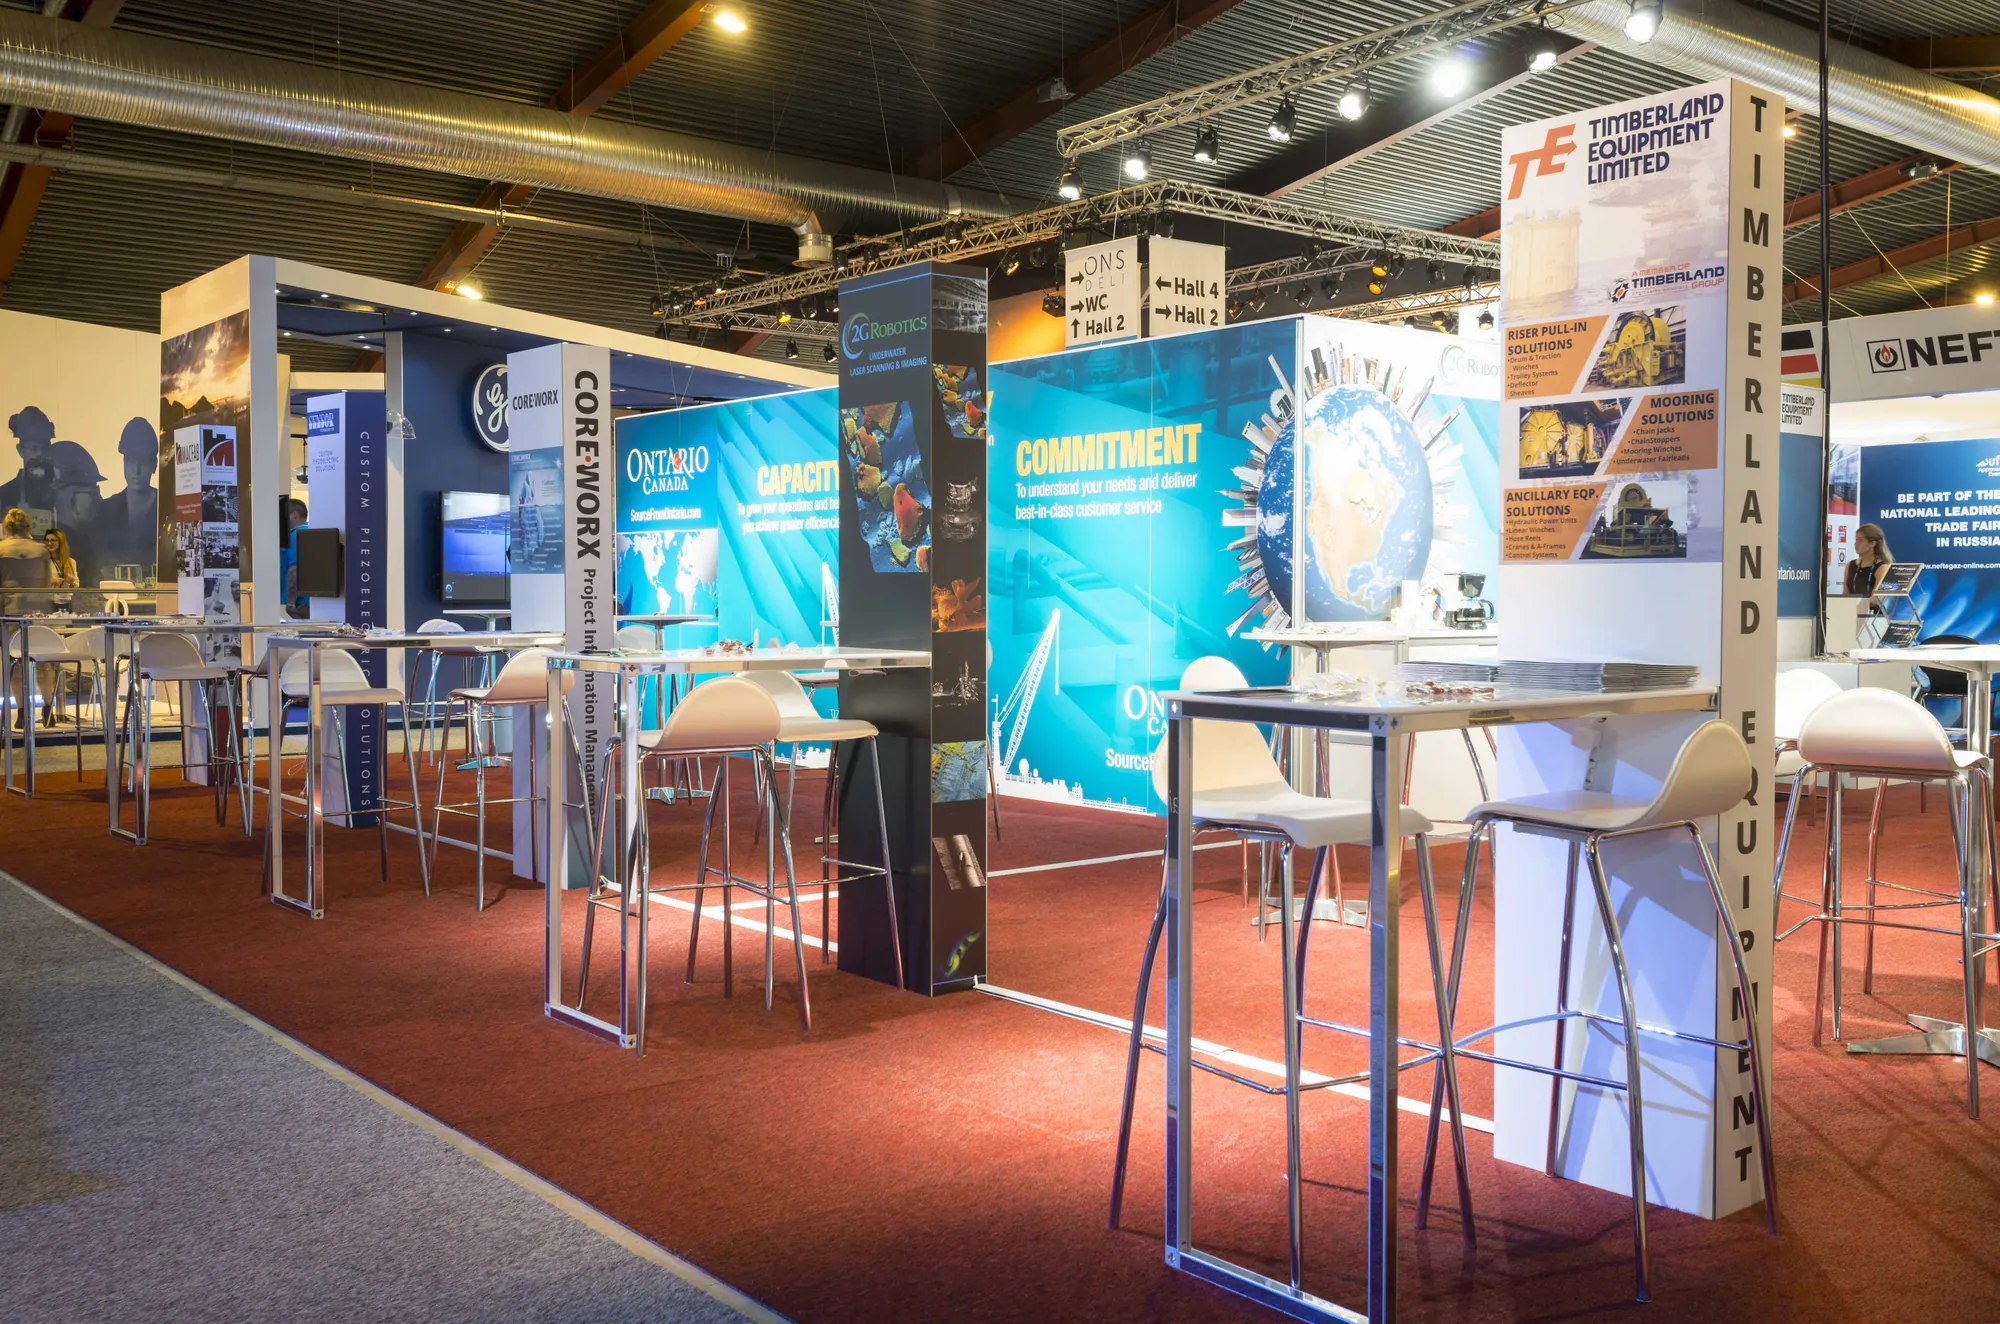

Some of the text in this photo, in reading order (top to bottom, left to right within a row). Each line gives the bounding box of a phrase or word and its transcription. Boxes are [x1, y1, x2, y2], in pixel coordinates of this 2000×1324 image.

[1588, 93, 1724, 139] TIMBERLAND
[1588, 118, 1714, 162] EQUIPMENT
[1588, 151, 1670, 185] LIMITED
[1639, 265, 1676, 276] MEMBER
[1677, 263, 1691, 271] OF
[1085, 273, 1125, 292] DELI
[1631, 266, 1725, 289] TIMBERLAND
[1691, 278, 1724, 289] GROUP
[1174, 277, 1219, 299] Hall 4
[1175, 305, 1219, 326] Hall 2
[1086, 314, 1125, 336] Hall 2
[1508, 321, 1587, 341] RISER PULL-IN
[869, 347, 907, 361] UNDERWATER
[1507, 338, 1573, 356] SOLUTIONS
[1510, 355, 1528, 364] Drum
[1535, 352, 1562, 361] Traction
[1740, 95, 1769, 635] TIMBERLAND
[849, 367, 866, 377] LASER
[866, 362, 895, 374] SCANNING
[901, 356, 927, 368] IMAGING
[1512, 363, 1539, 371] Winches
[1510, 369, 1558, 382] Trolley Systems
[1510, 380, 1538, 389] Deflector
[1509, 389, 1535, 397] Sheaves
[1650, 393, 1714, 408] MOORING
[1782, 393, 1815, 406] TIMBERLAND
[1641, 409, 1715, 425] SOLUTIONS
[1782, 403, 1813, 416] EQUIPMENT
[1781, 413, 1803, 425] LIMITED
[1636, 426, 1675, 436] Chain Jacks
[1016, 423, 1202, 477] COMMITMENT
[1623, 445, 1682, 456] Mooring Winches
[1616, 454, 1690, 465] Underwater Fairleads
[643, 476, 689, 495] CANADA
[1016, 472, 1198, 498] To understand your needs and deliver
[1506, 488, 1599, 502] ANCILLARY EQP.
[1898, 489, 2000, 503] BE PART OF THE
[630, 506, 702, 522] SourceFromOntario.com
[737, 496, 839, 517] To grow your operations and hel
[1015, 498, 1162, 520] best-in-class customer service
[1506, 505, 1571, 517] SOLUTIONS
[1880, 505, 2000, 519] NATIONAL LEADING
[742, 521, 755, 535] you
[755, 519, 779, 531] achieve
[780, 518, 804, 533] greater
[1509, 518, 1538, 526] Hydraulic
[1925, 520, 2000, 532] TRADE FAIR
[1936, 535, 2000, 547] IN RUSSIA
[1532, 551, 1558, 559] Systems
[581, 569, 598, 625] Project
[360, 431, 371, 806] CUSTOM PIEZOELECRIC OLUTIONS
[584, 630, 598, 724] Infmation
